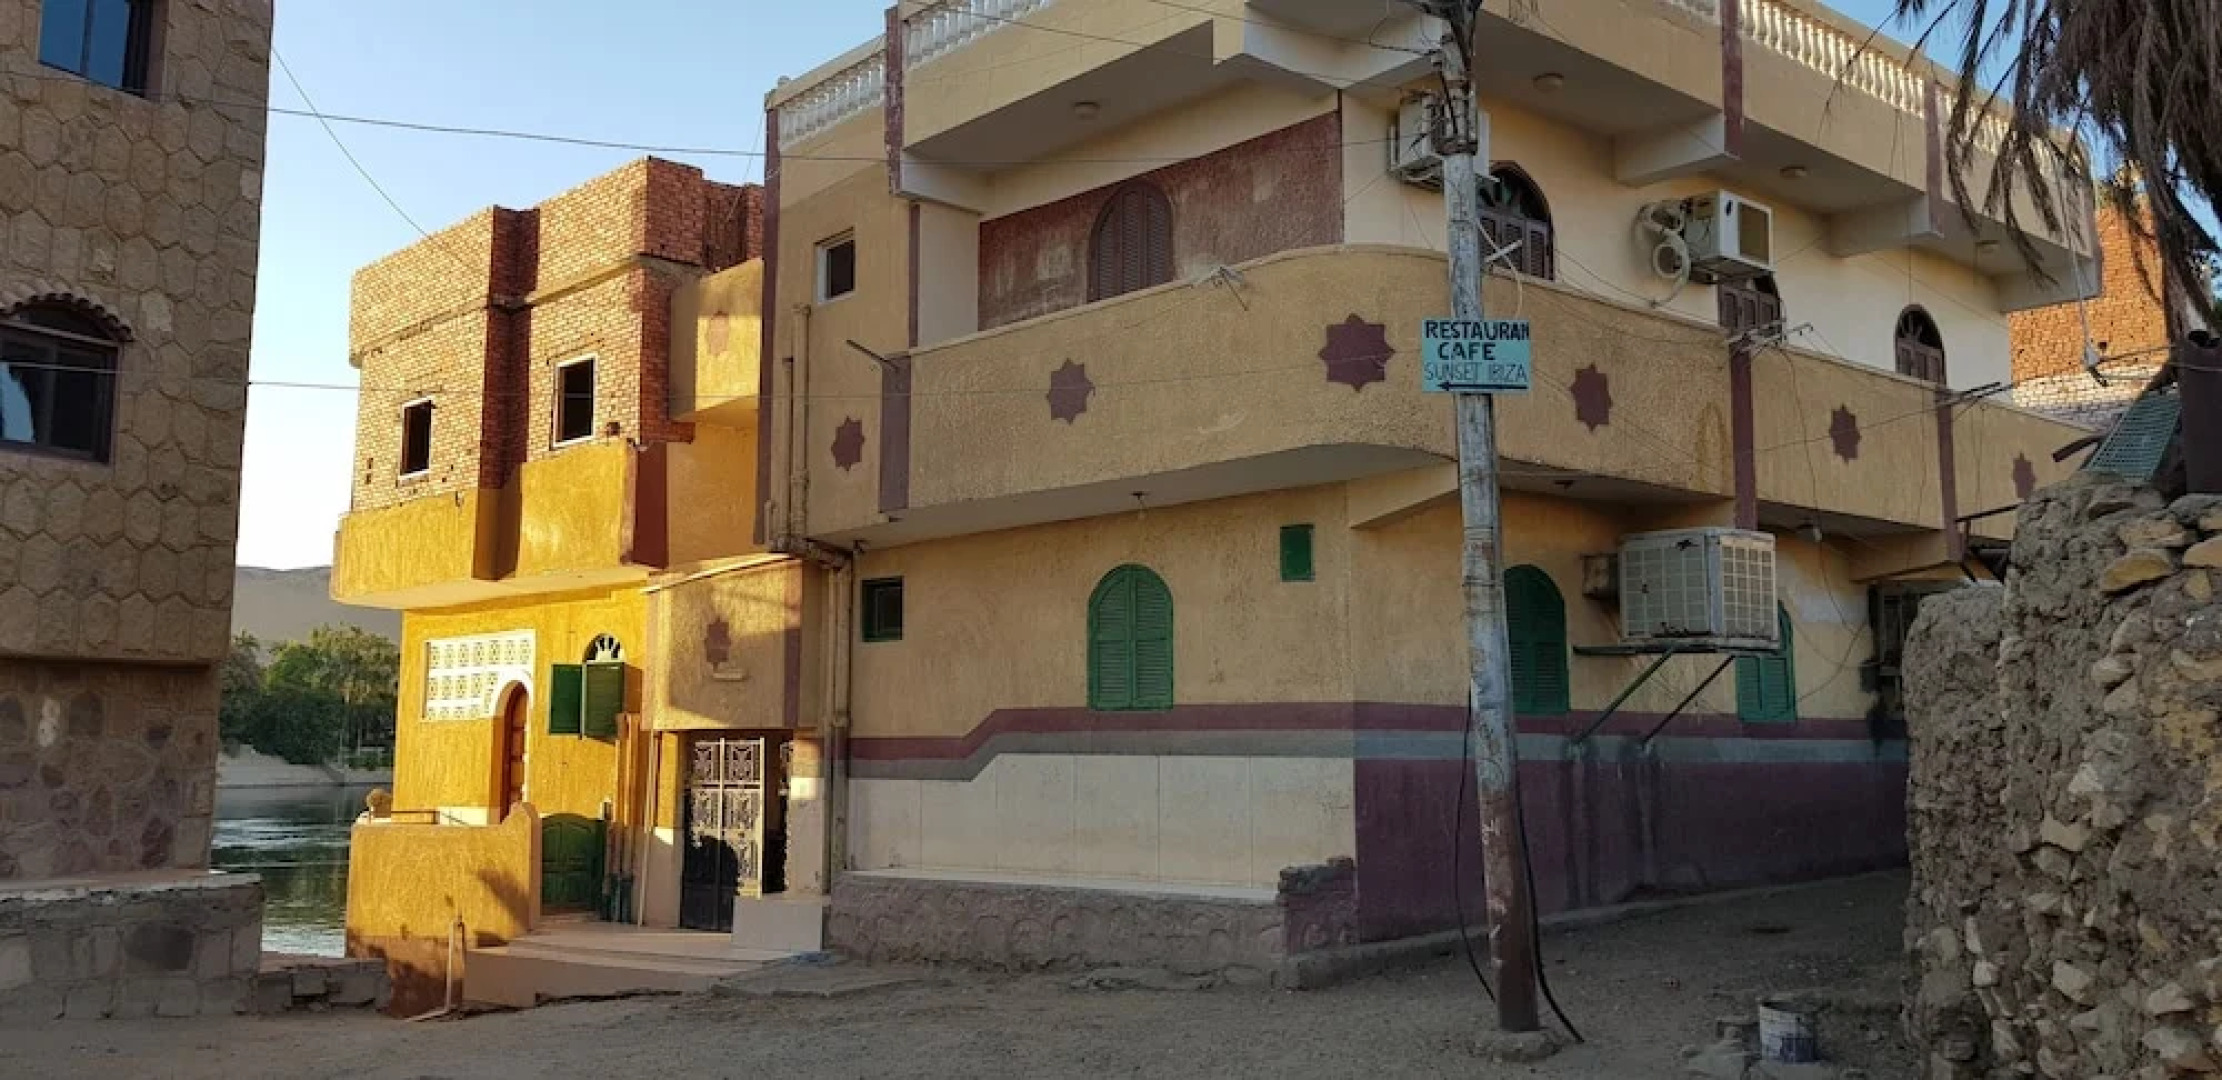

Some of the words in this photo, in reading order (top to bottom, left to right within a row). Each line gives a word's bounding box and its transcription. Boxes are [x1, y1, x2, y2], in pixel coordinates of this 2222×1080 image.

[1438, 342, 1496, 360] CAFE
[1424, 362, 1482, 380] SUNSET
[1488, 363, 1527, 381] IBIZA
